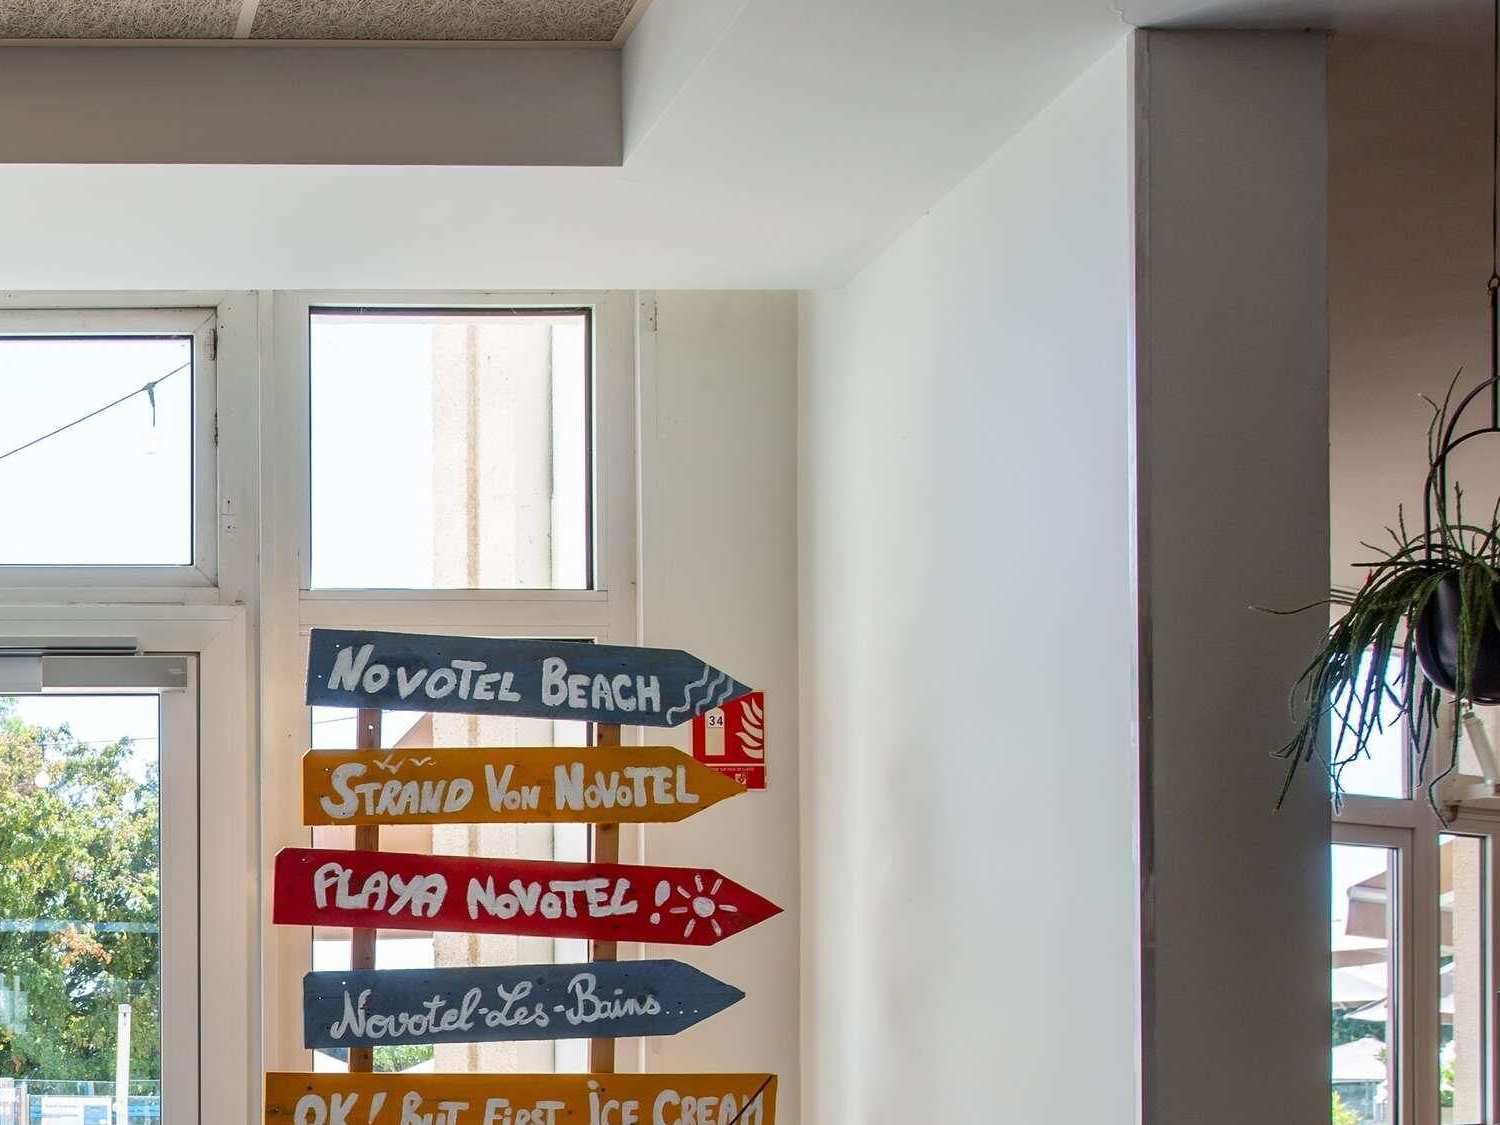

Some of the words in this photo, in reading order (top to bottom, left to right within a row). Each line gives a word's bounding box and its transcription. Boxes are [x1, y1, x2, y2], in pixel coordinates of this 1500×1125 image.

[328, 644, 521, 704] NOVOTEL
[542, 656, 661, 713] BEACH
[320, 762, 474, 819] STRAND
[555, 763, 699, 811] NOVOTEL
[313, 862, 448, 918] PLAYA
[467, 875, 639, 919] NOVOTEL
